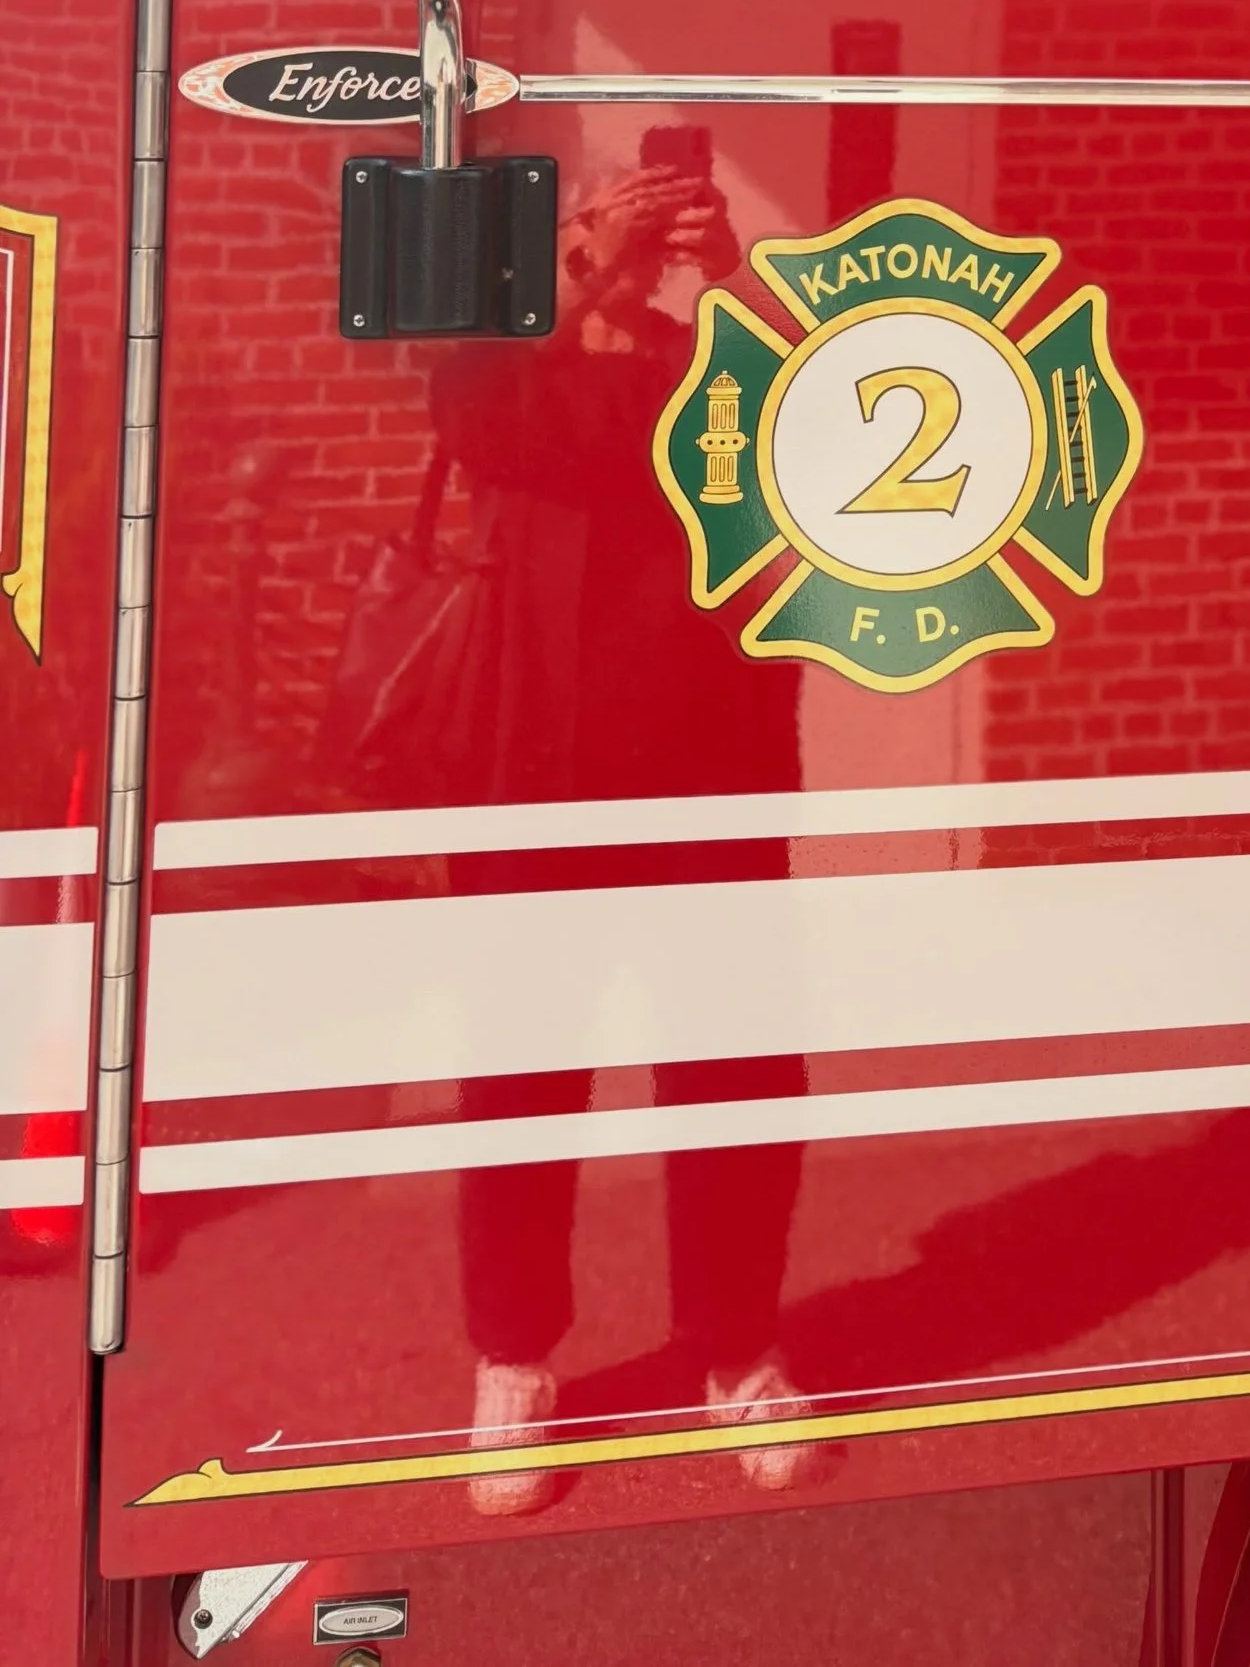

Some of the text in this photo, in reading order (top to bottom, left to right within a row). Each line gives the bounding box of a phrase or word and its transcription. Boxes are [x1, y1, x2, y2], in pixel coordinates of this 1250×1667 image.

[269, 62, 420, 113] Enforce
[799, 243, 1015, 305] KATONAH
[834, 365, 971, 518] 2
[850, 606, 959, 645] F. D.
[343, 1615, 378, 1625] AIR INLET
